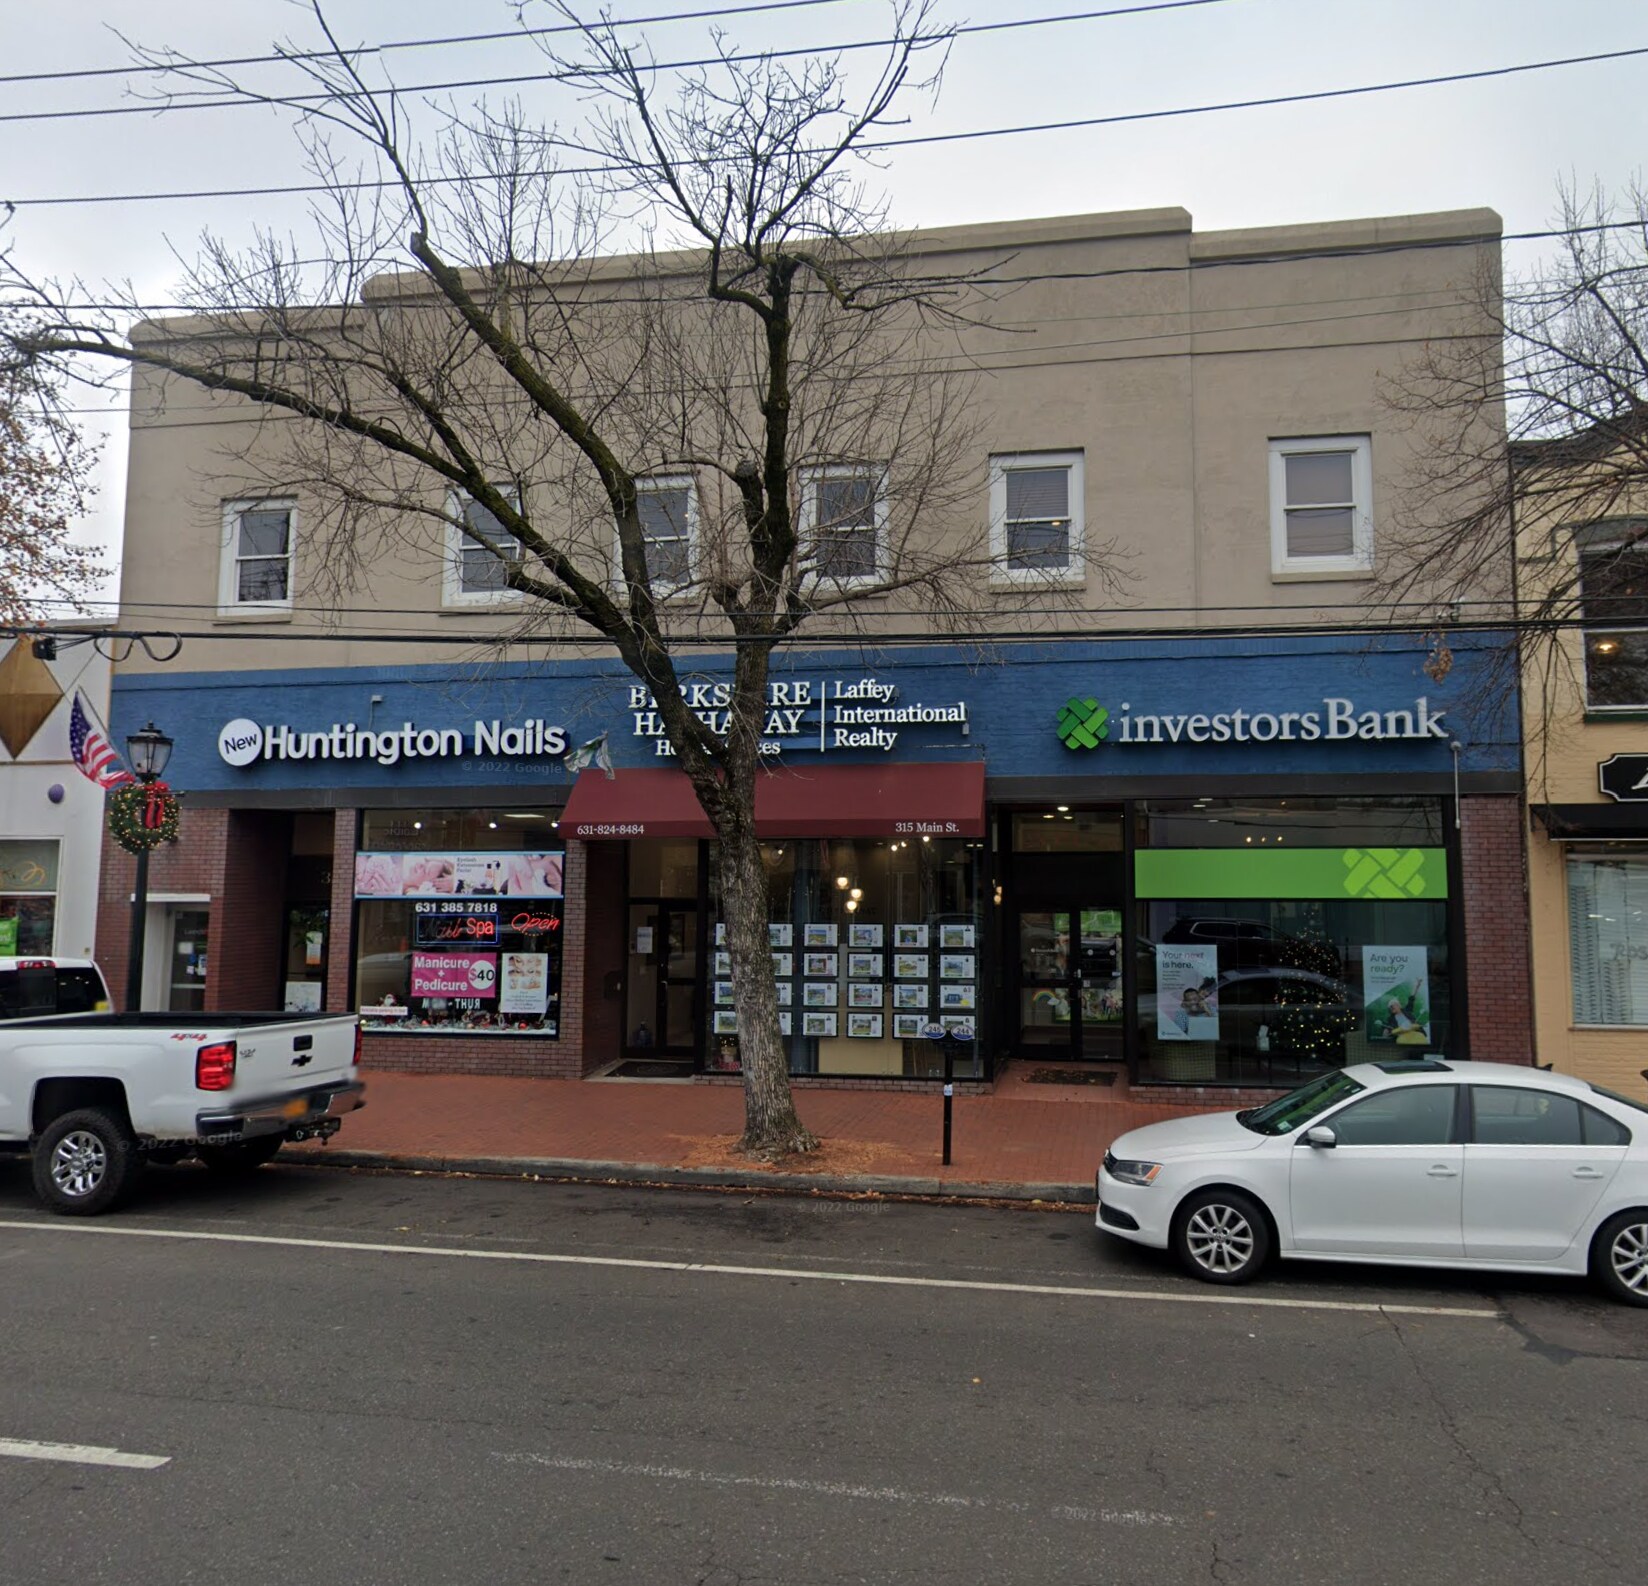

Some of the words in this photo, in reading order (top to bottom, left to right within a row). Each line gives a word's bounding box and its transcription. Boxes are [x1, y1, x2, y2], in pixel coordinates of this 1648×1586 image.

[628, 681, 811, 709] BRKSRE
[834, 680, 895, 703] Laffey
[834, 702, 966, 723] International
[1119, 696, 1450, 742] investorsBank
[224, 731, 258, 755] New
[263, 722, 462, 765] Huntington
[474, 719, 566, 755] Nails
[834, 728, 897, 750] Realty
[577, 824, 645, 835] 631-824-8484
[895, 822, 913, 832] 315
[916, 822, 943, 832] Main
[945, 822, 960, 832] St.
[415, 903, 436, 912] 631
[441, 903, 463, 912] 385
[468, 903, 497, 912] 7818
[466, 917, 494, 938] Spa
[511, 912, 560, 933] Open
[1162, 951, 1182, 960] Your
[1370, 953, 1387, 962] Are
[1389, 955, 1408, 964] you
[414, 957, 470, 968] Manicure
[1162, 960, 1170, 969] is
[1171, 960, 1194, 969] here.
[469, 968, 496, 981] $40
[1370, 964, 1405, 974] ready?
[414, 979, 468, 991] Pedicure
